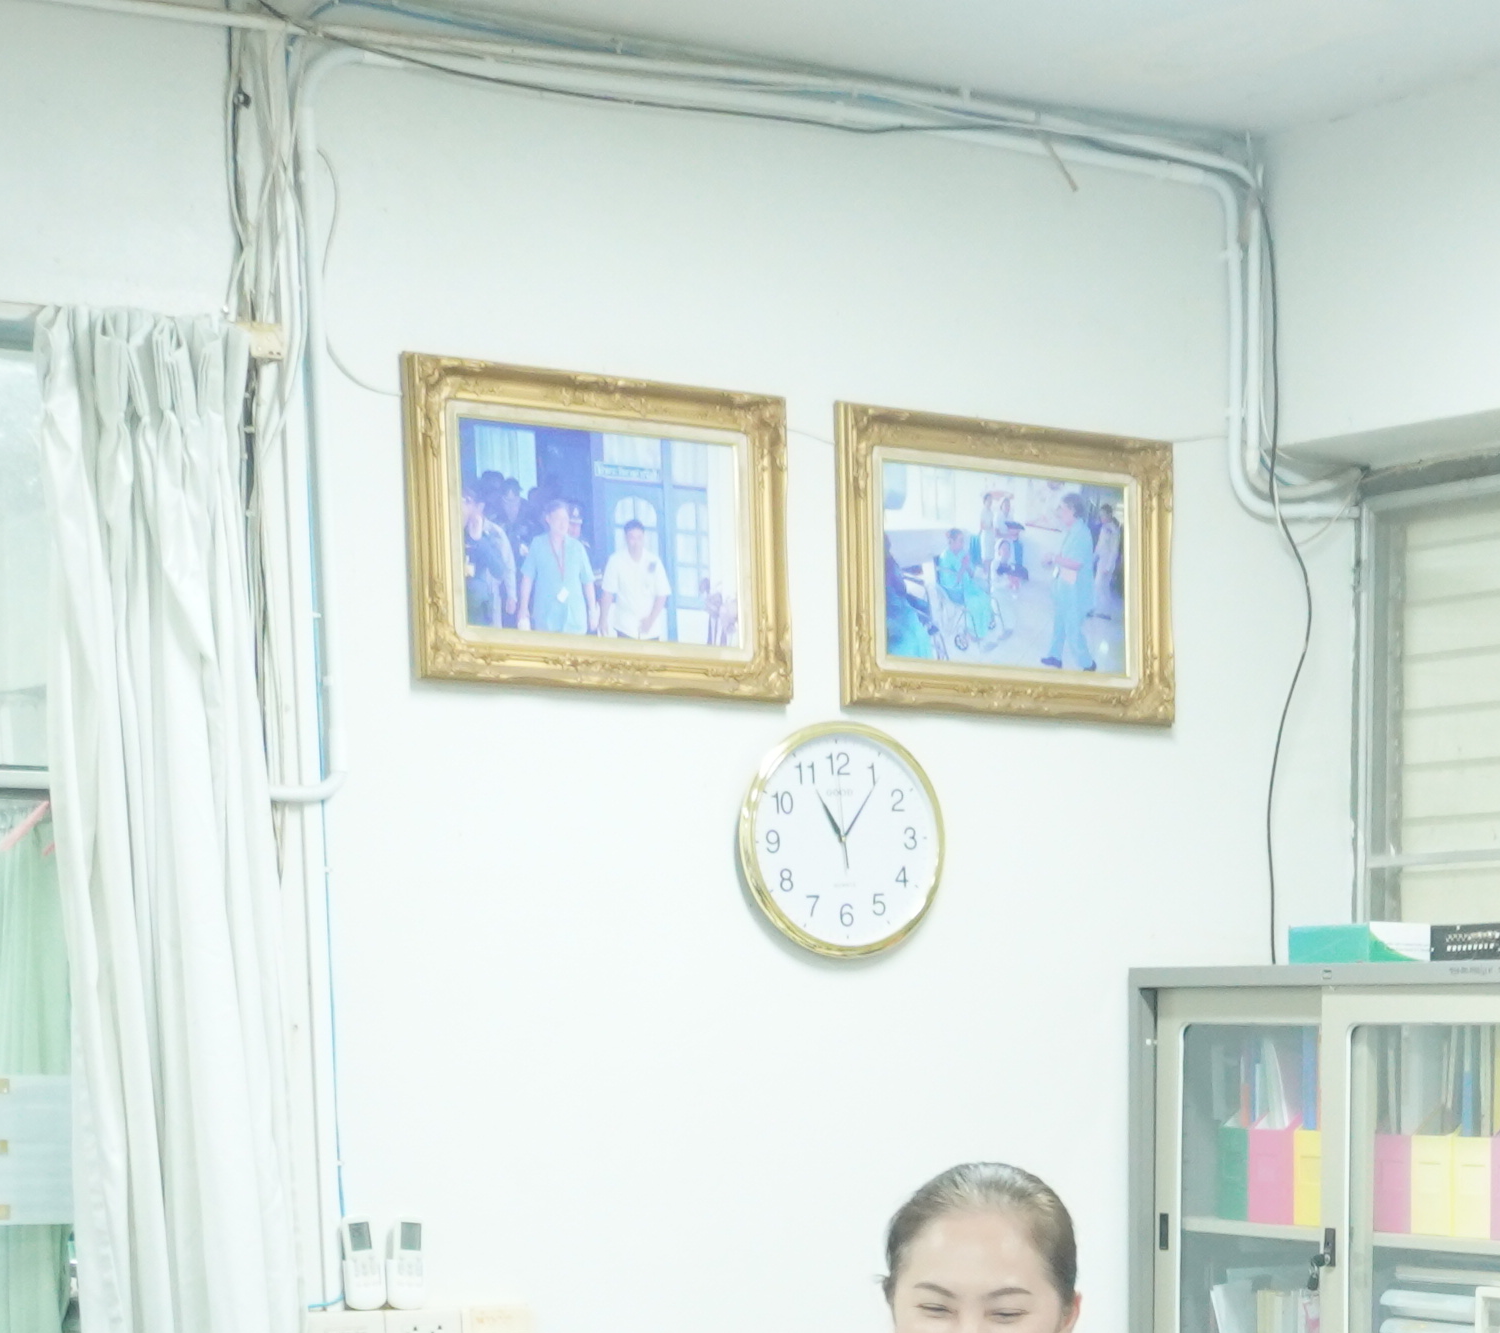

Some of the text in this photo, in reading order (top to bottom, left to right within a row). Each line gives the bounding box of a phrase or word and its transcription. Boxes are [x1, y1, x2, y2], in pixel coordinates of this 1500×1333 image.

[794, 761, 815, 785] 11
[826, 752, 850, 776] 12
[867, 762, 877, 786] 1
[771, 790, 794, 815] 10
[891, 788, 906, 812] 2
[765, 829, 781, 854] 9
[903, 826, 918, 851] 3
[779, 868, 794, 892] 8
[895, 866, 909, 888] 4
[805, 894, 820, 918] 7
[839, 903, 854, 927] 6
[872, 893, 887, 916] 5
